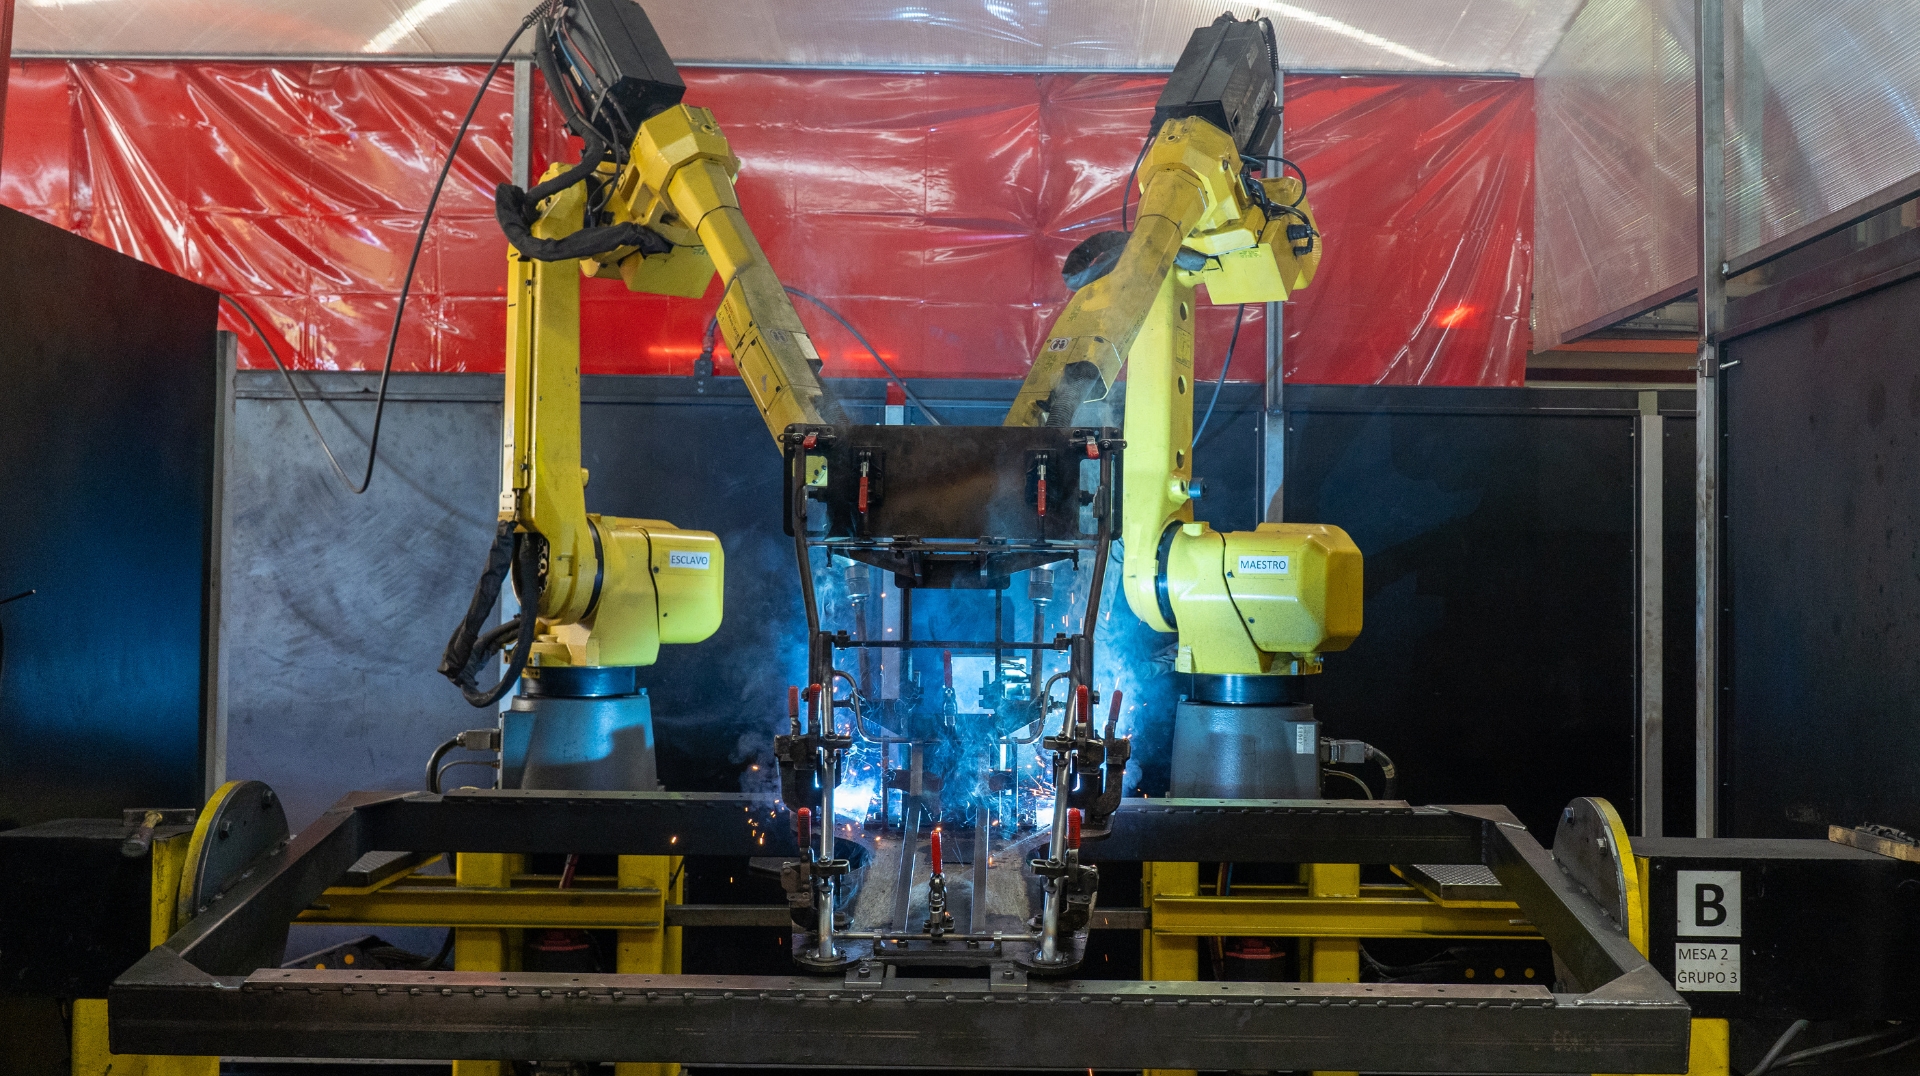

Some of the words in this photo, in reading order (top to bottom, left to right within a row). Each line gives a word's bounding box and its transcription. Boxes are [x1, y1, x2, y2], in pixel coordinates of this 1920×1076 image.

[671, 555, 708, 565] ESCLAVO
[1240, 560, 1287, 570] MAESTRO
[1695, 883, 1727, 927] B
[1678, 948, 1717, 960] MESA
[1720, 948, 1729, 960] 2
[1677, 971, 1726, 984] GRUPO
[1729, 971, 1738, 984] 3
